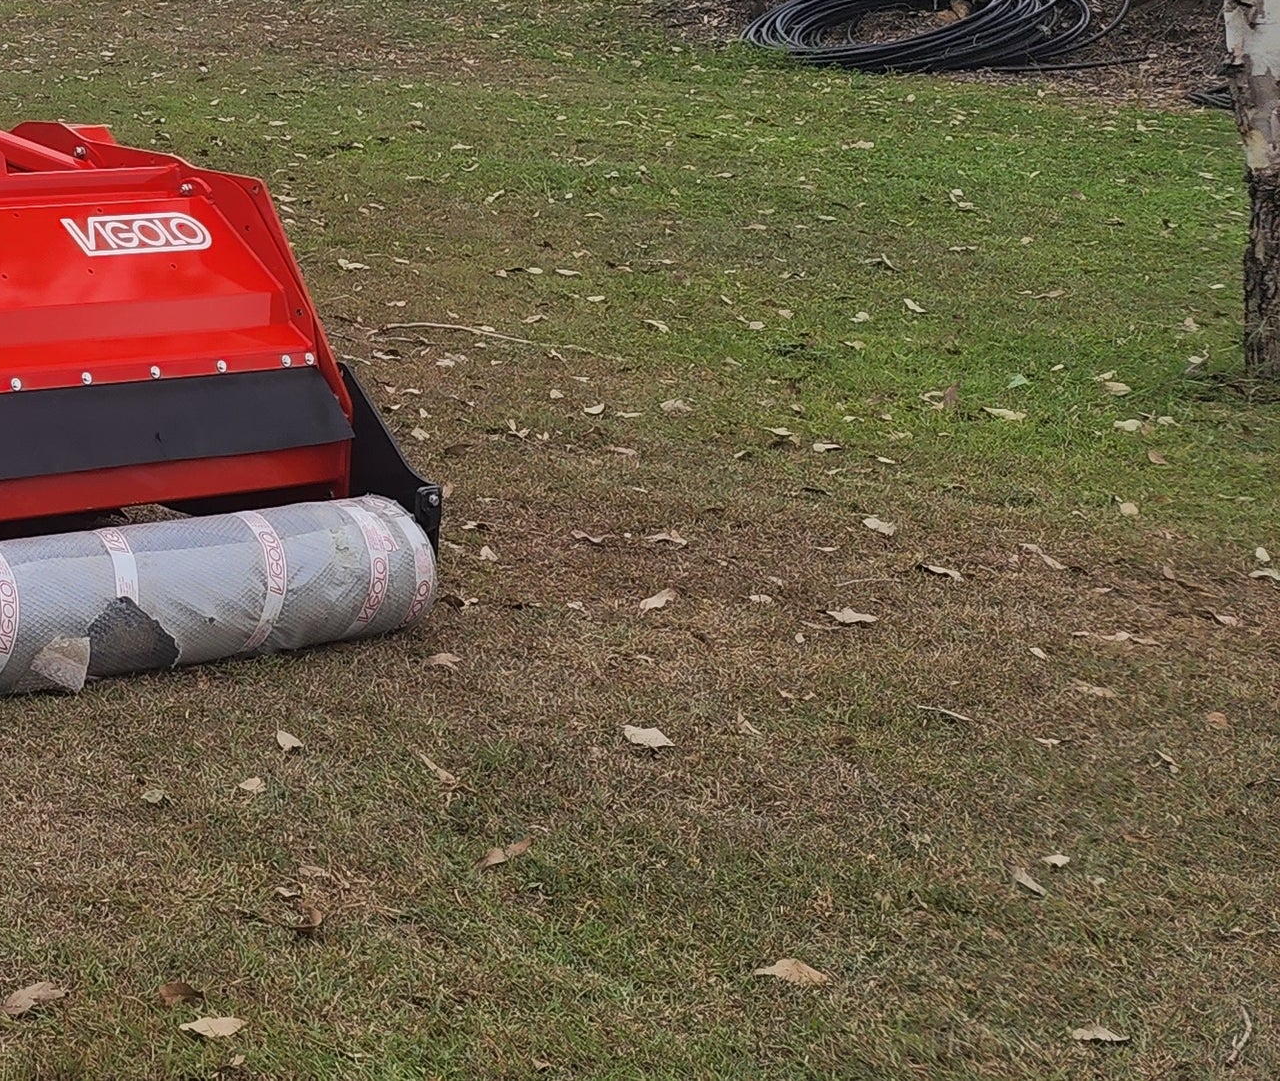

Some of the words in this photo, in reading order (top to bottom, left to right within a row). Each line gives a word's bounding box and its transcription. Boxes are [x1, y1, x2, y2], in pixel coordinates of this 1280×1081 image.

[60, 212, 213, 256] VIGOLO
[259, 530, 285, 595] VIGOLO
[357, 556, 387, 623] VIGOLO
